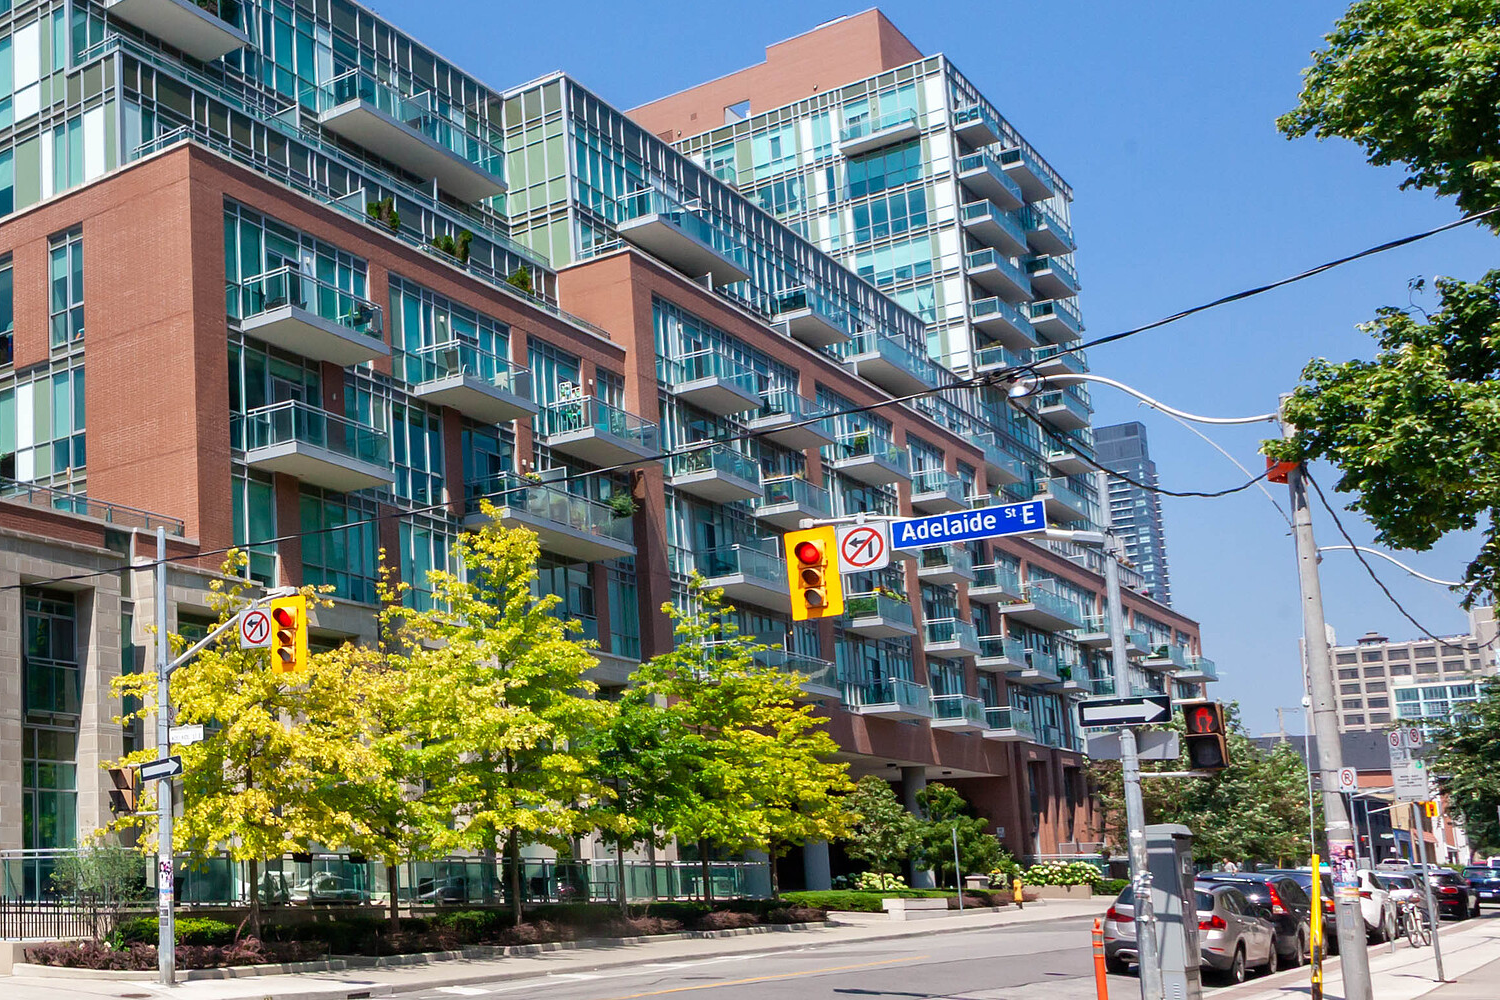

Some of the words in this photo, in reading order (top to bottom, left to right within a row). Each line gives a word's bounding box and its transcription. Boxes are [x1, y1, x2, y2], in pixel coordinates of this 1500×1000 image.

[901, 513, 997, 542] Adelaide
[1004, 508, 1017, 518] St
[1022, 504, 1036, 525] E
